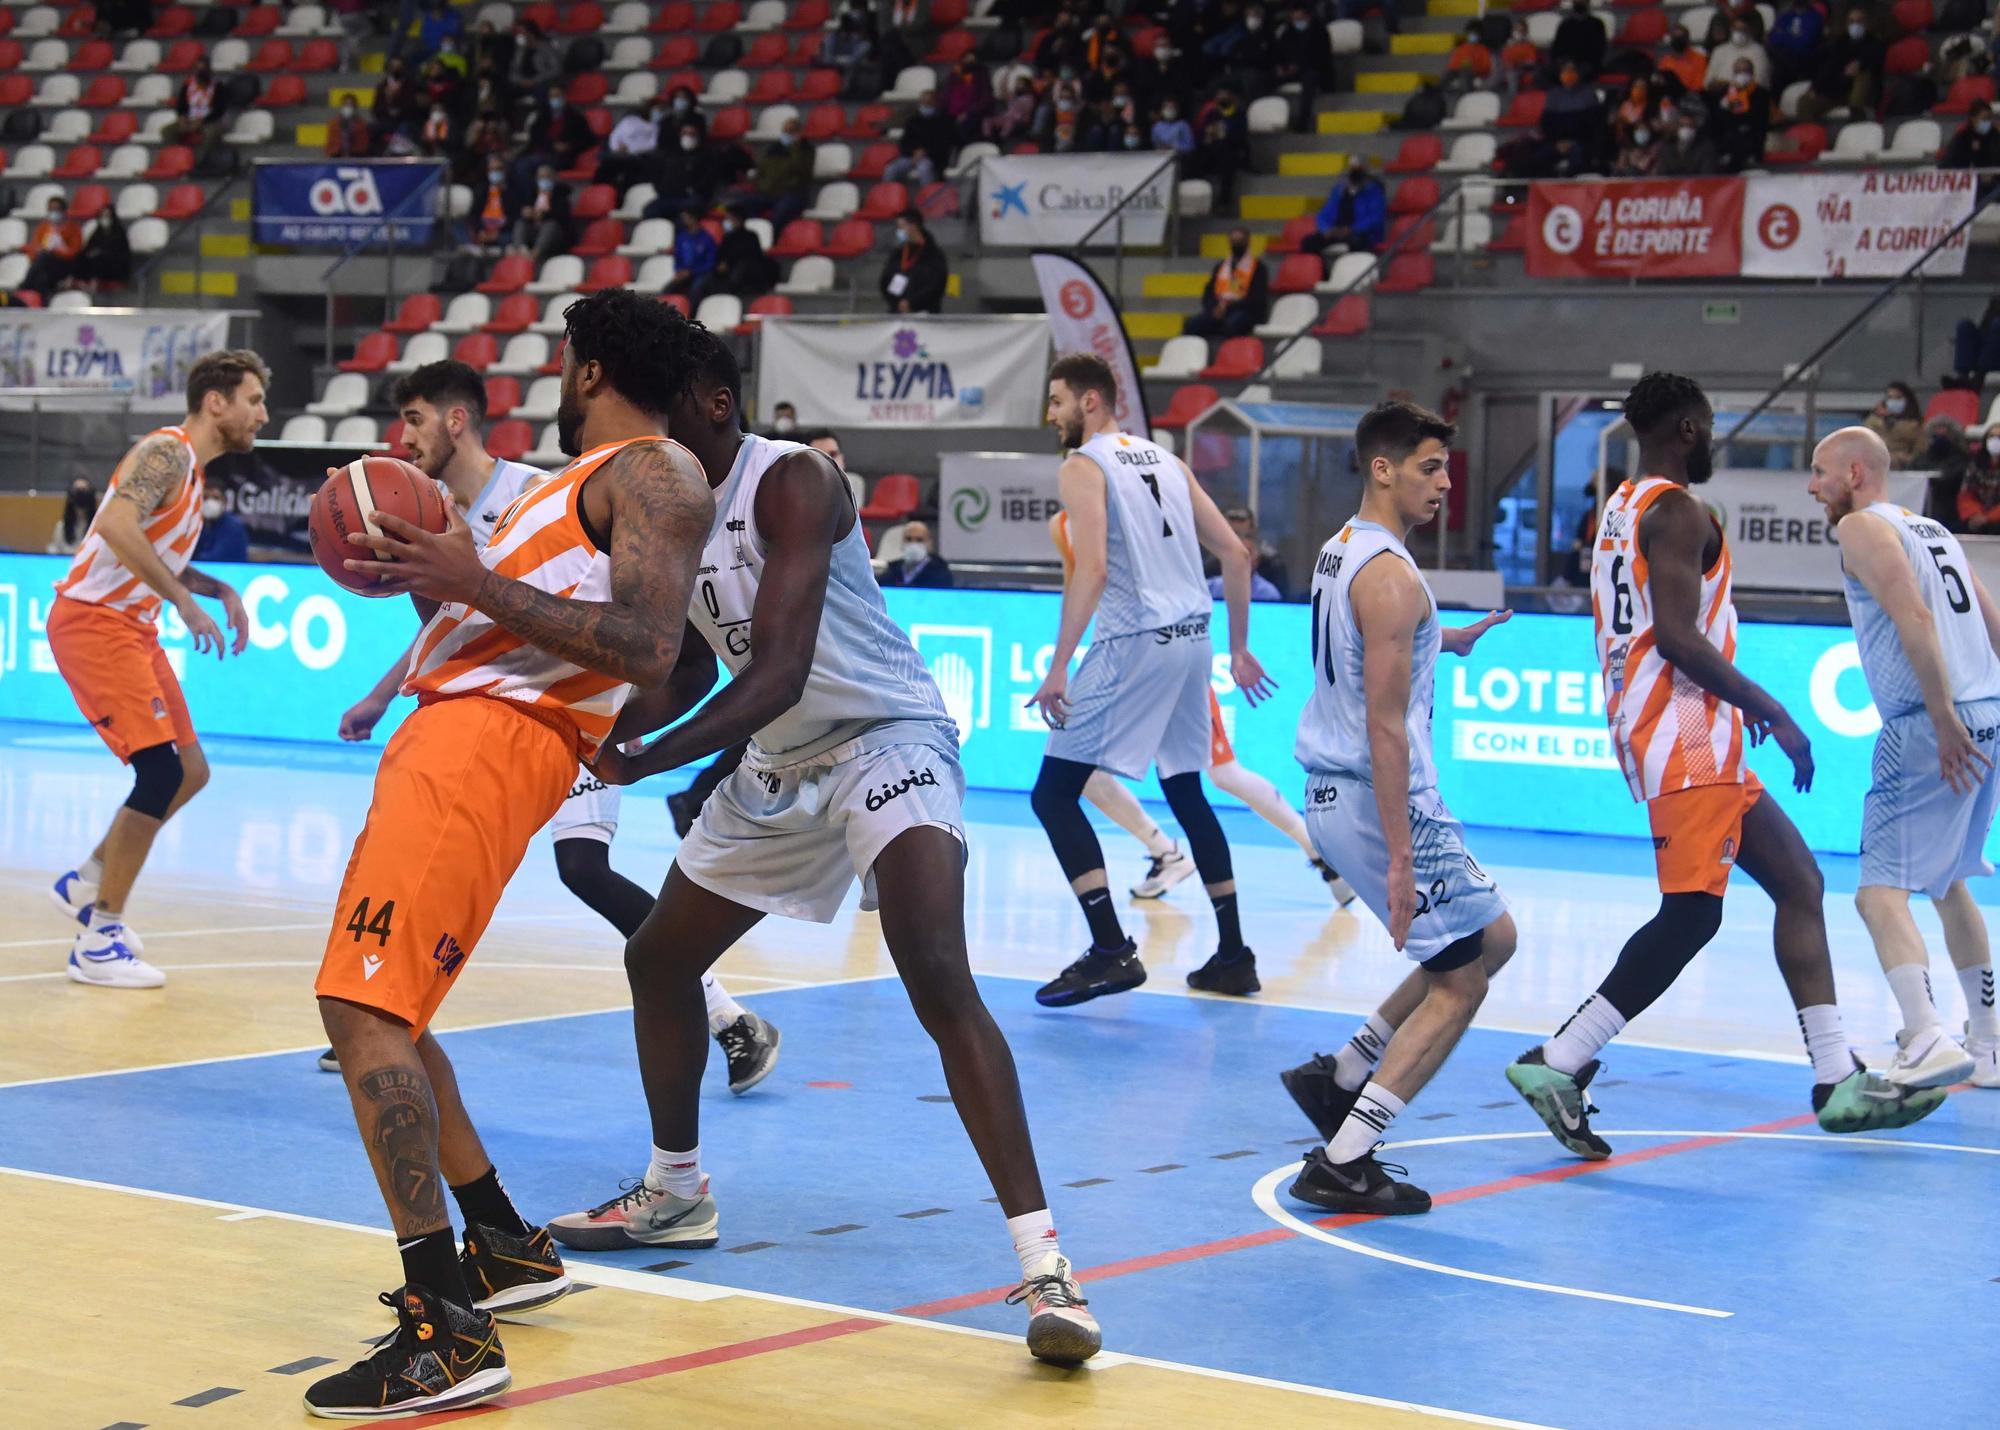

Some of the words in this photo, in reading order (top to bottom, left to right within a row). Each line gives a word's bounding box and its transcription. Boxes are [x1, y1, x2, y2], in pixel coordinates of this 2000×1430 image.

[1594, 200, 1613, 224] A
[1615, 191, 1704, 223] CORUÑA
[1613, 226, 1712, 254] DEPORTE
[47, 350, 125, 378] LEYMA
[856, 361, 955, 400] LEYMA
[1140, 473, 1174, 538] 7
[1610, 554, 1634, 635] 6
[1927, 545, 1971, 614] 5
[1472, 732, 1528, 753] CON
[1537, 734, 1566, 756] EL
[345, 896, 396, 948] 44
